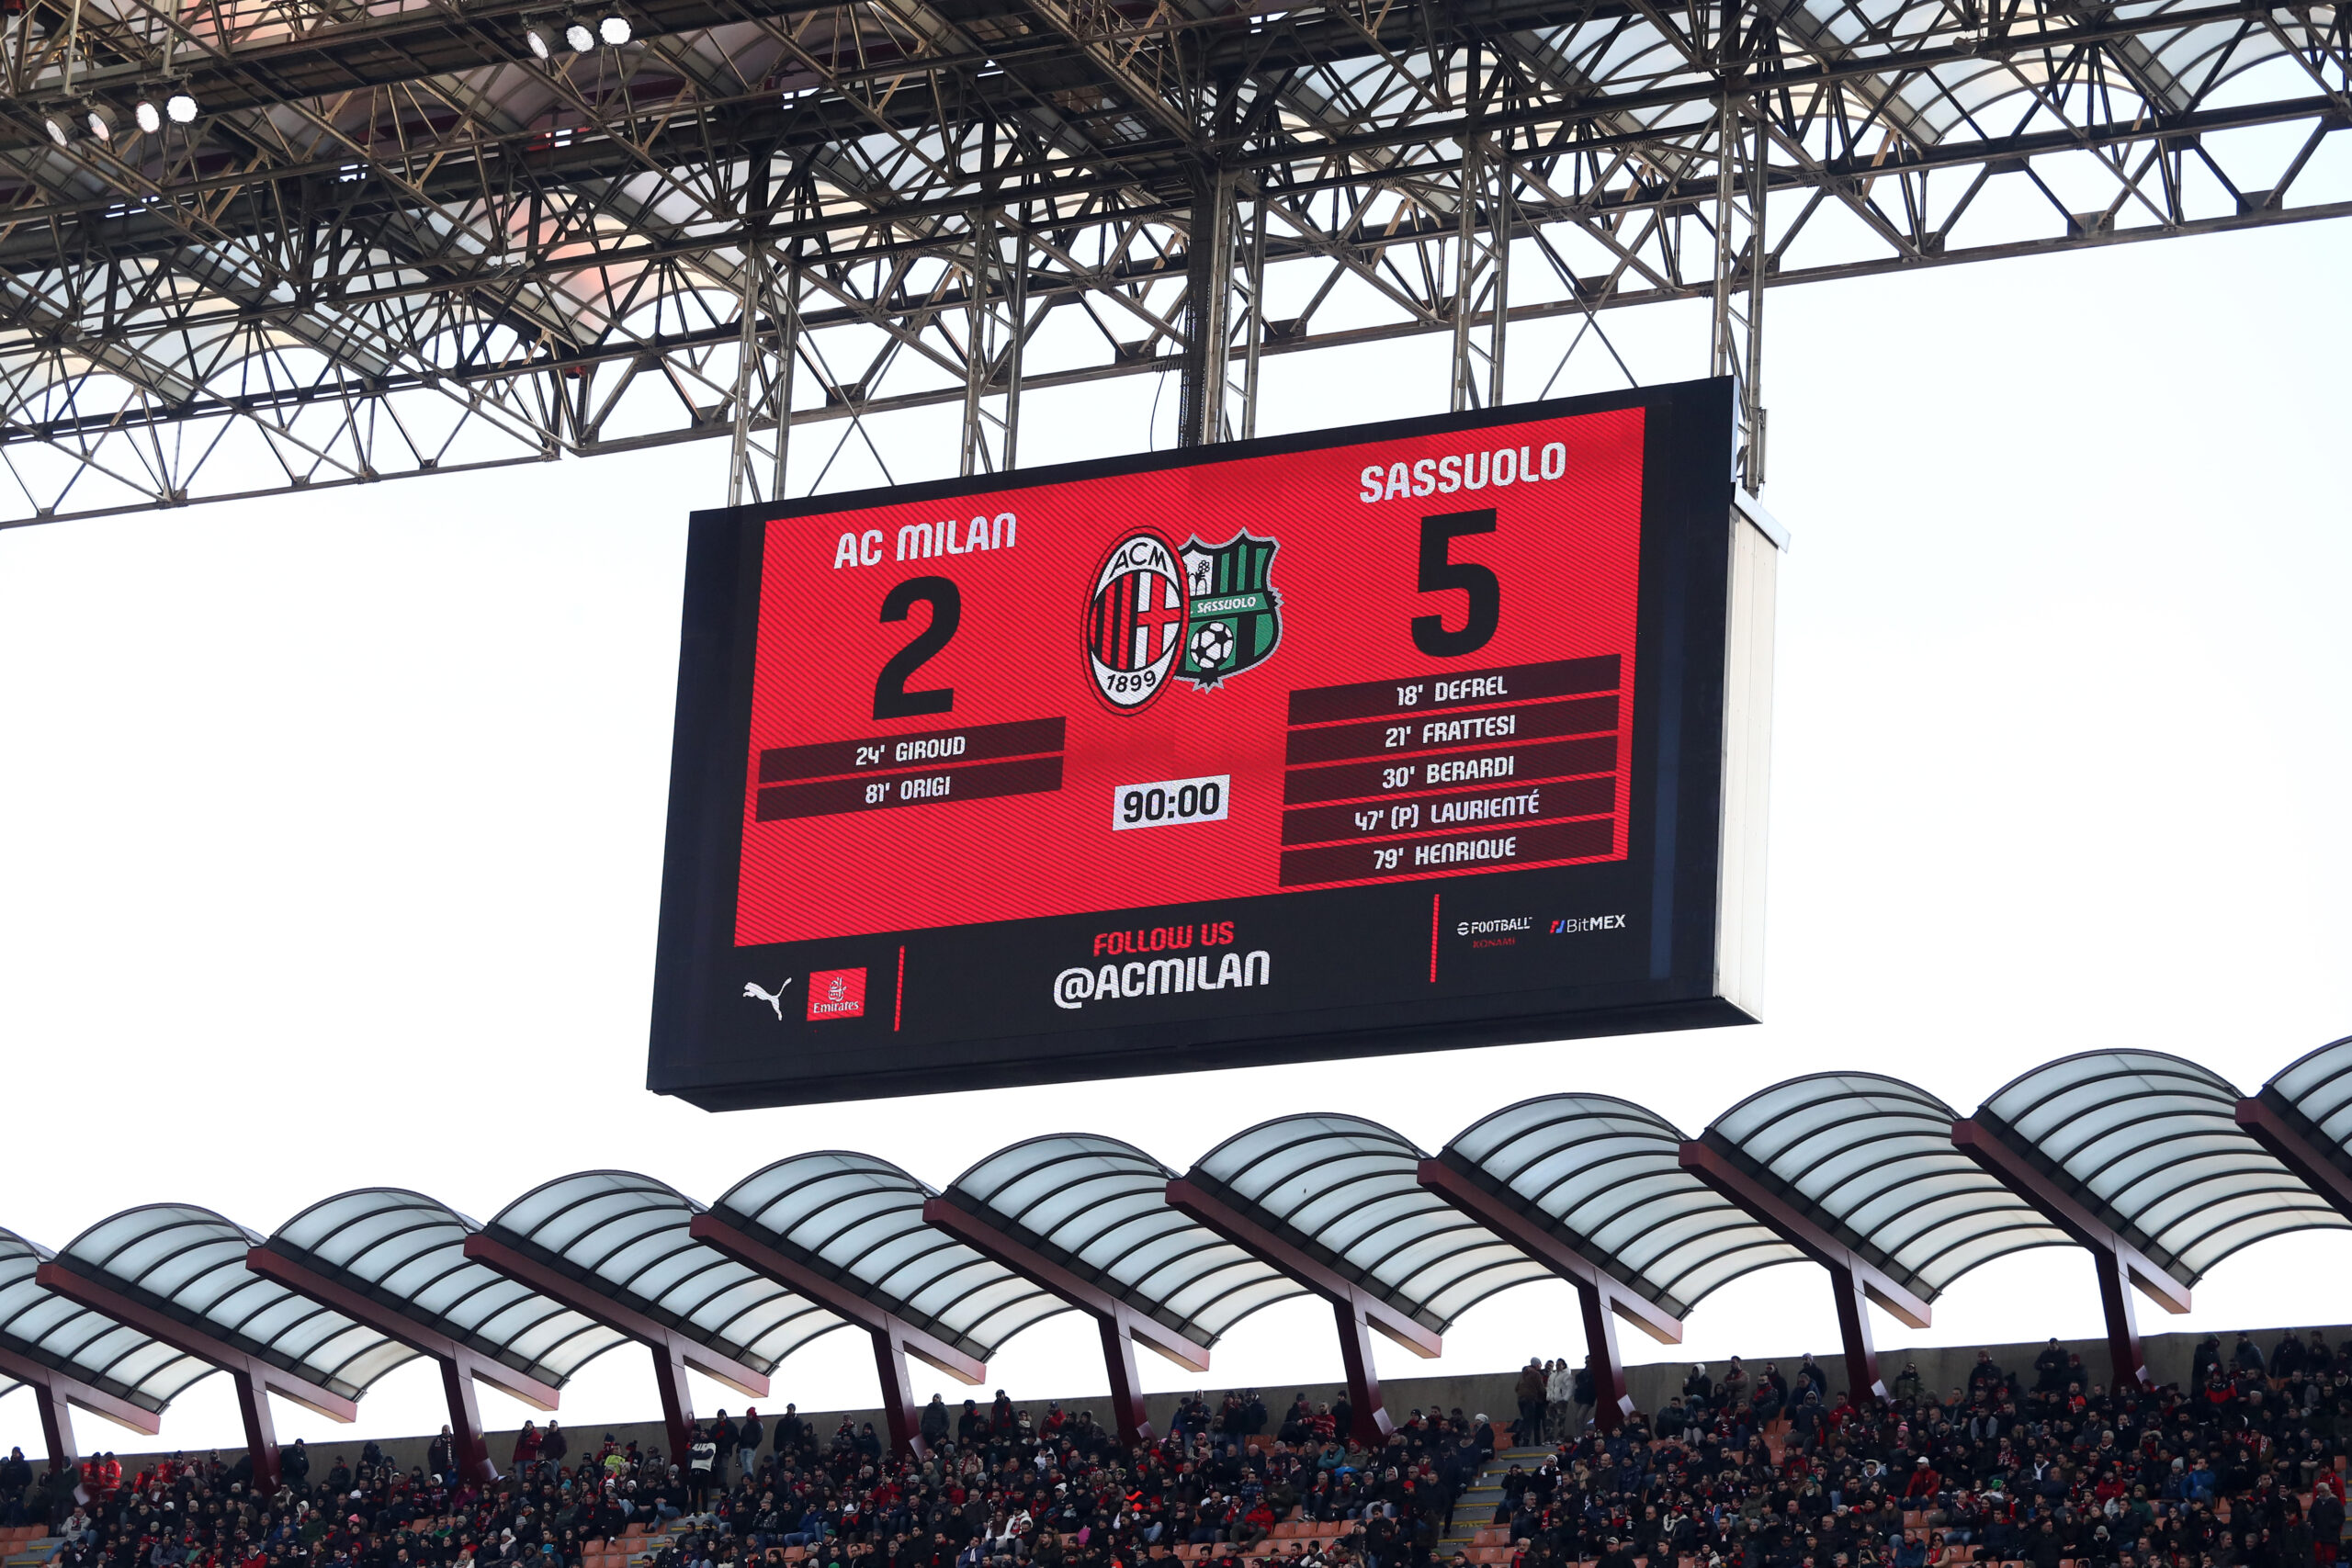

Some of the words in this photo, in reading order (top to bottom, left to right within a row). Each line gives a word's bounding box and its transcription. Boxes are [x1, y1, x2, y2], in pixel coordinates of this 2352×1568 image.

[1360, 442, 1566, 503] SASSUOLO
[833, 529, 883, 569] AC
[896, 512, 1016, 561] MILAN
[1108, 542, 1168, 580] ACM
[1411, 507, 1499, 658] 5
[1197, 596, 1256, 614] SASSUOLO
[873, 575, 961, 720] 2
[1106, 670, 1157, 693] 1899
[1396, 684, 1423, 706] 18'
[1434, 675, 1508, 703] DEFREL
[1385, 727, 1411, 748] 21'
[1423, 716, 1515, 744] FRATTESI
[855, 746, 885, 766] 24'
[895, 736, 966, 761] GIROUD
[1382, 767, 1416, 789] 30'
[1426, 757, 1514, 784] BERARDI
[865, 783, 890, 804] 81'
[899, 776, 951, 799] ORIGI
[1123, 782, 1220, 823] 90:00
[1354, 808, 1384, 831] 47'
[1391, 805, 1419, 829] (P)
[1430, 788, 1540, 825] LAURIENTÉ
[1374, 849, 1404, 870] 79'
[1415, 836, 1517, 867] HENRIQUE
[1093, 925, 1193, 957] FOLLOW
[1201, 920, 1235, 945] US
[1566, 914, 1626, 933] BitMEX
[1473, 937, 1516, 948] KONAMI
[1053, 950, 1270, 1010] @ACMILAN
[813, 1000, 859, 1014] Emirates
